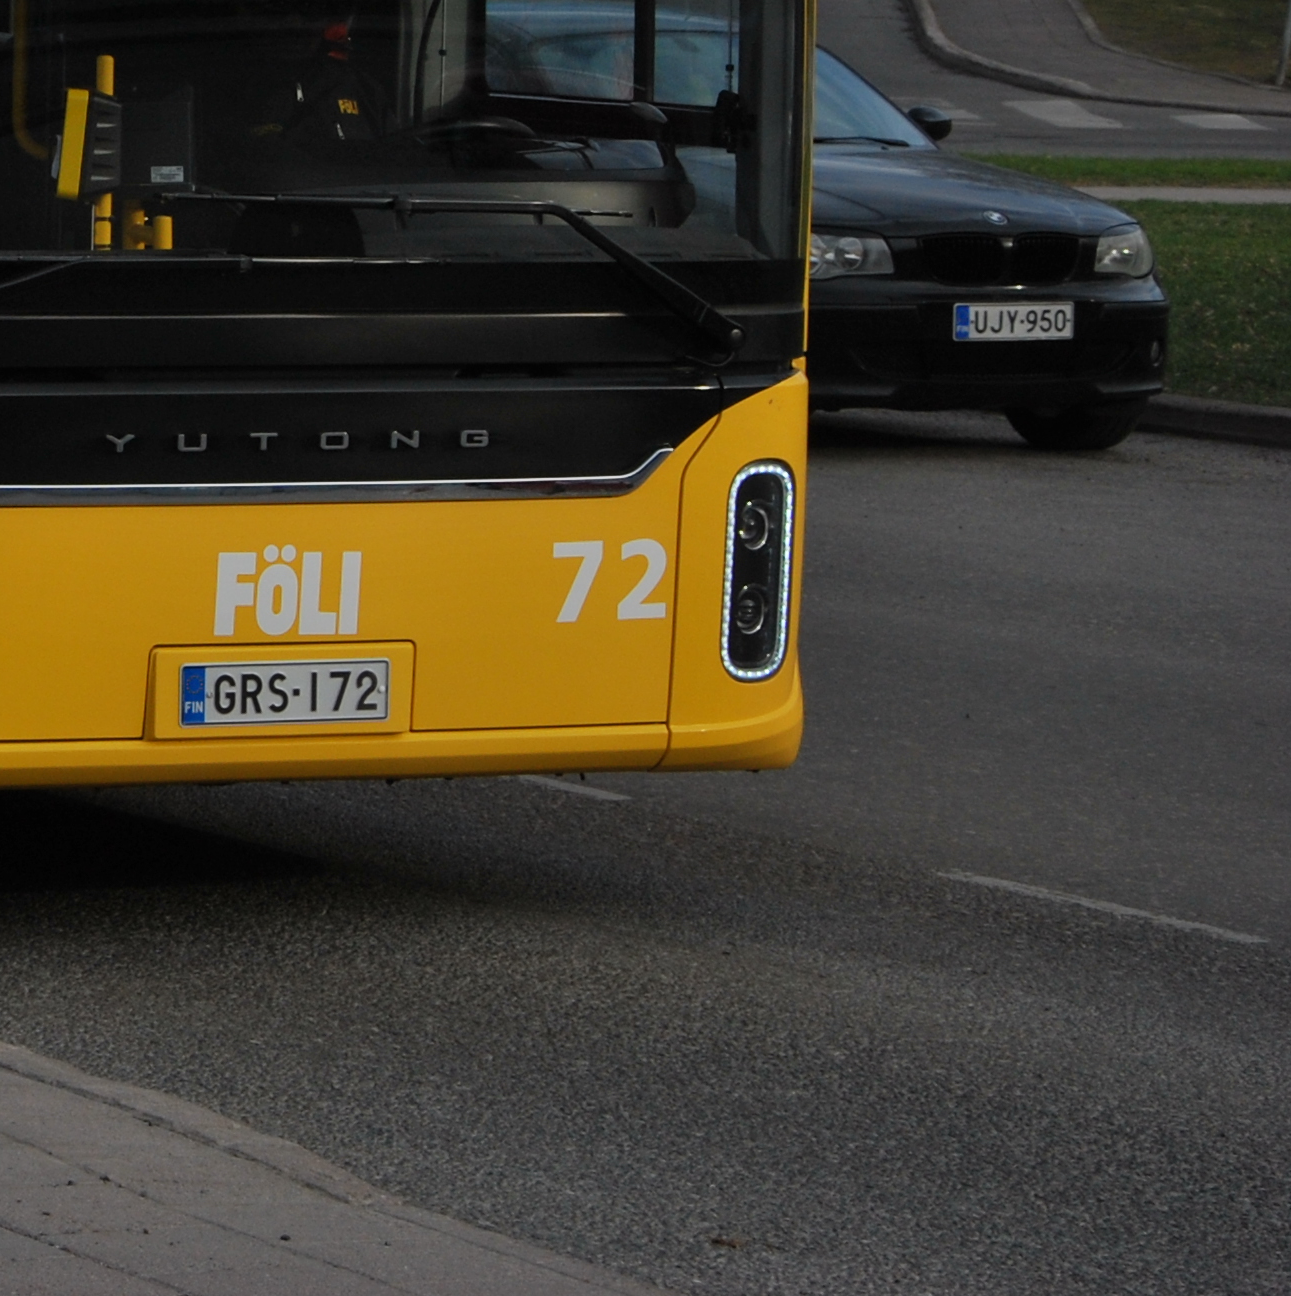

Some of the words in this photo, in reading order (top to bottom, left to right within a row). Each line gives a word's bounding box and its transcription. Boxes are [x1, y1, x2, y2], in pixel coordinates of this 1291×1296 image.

[974, 309, 1067, 334] UJY-950
[106, 429, 490, 453] YUTONG
[213, 544, 362, 636] FÖLI
[552, 538, 668, 624] 72
[184, 699, 205, 715] FIN
[212, 669, 379, 716] GRS-172
